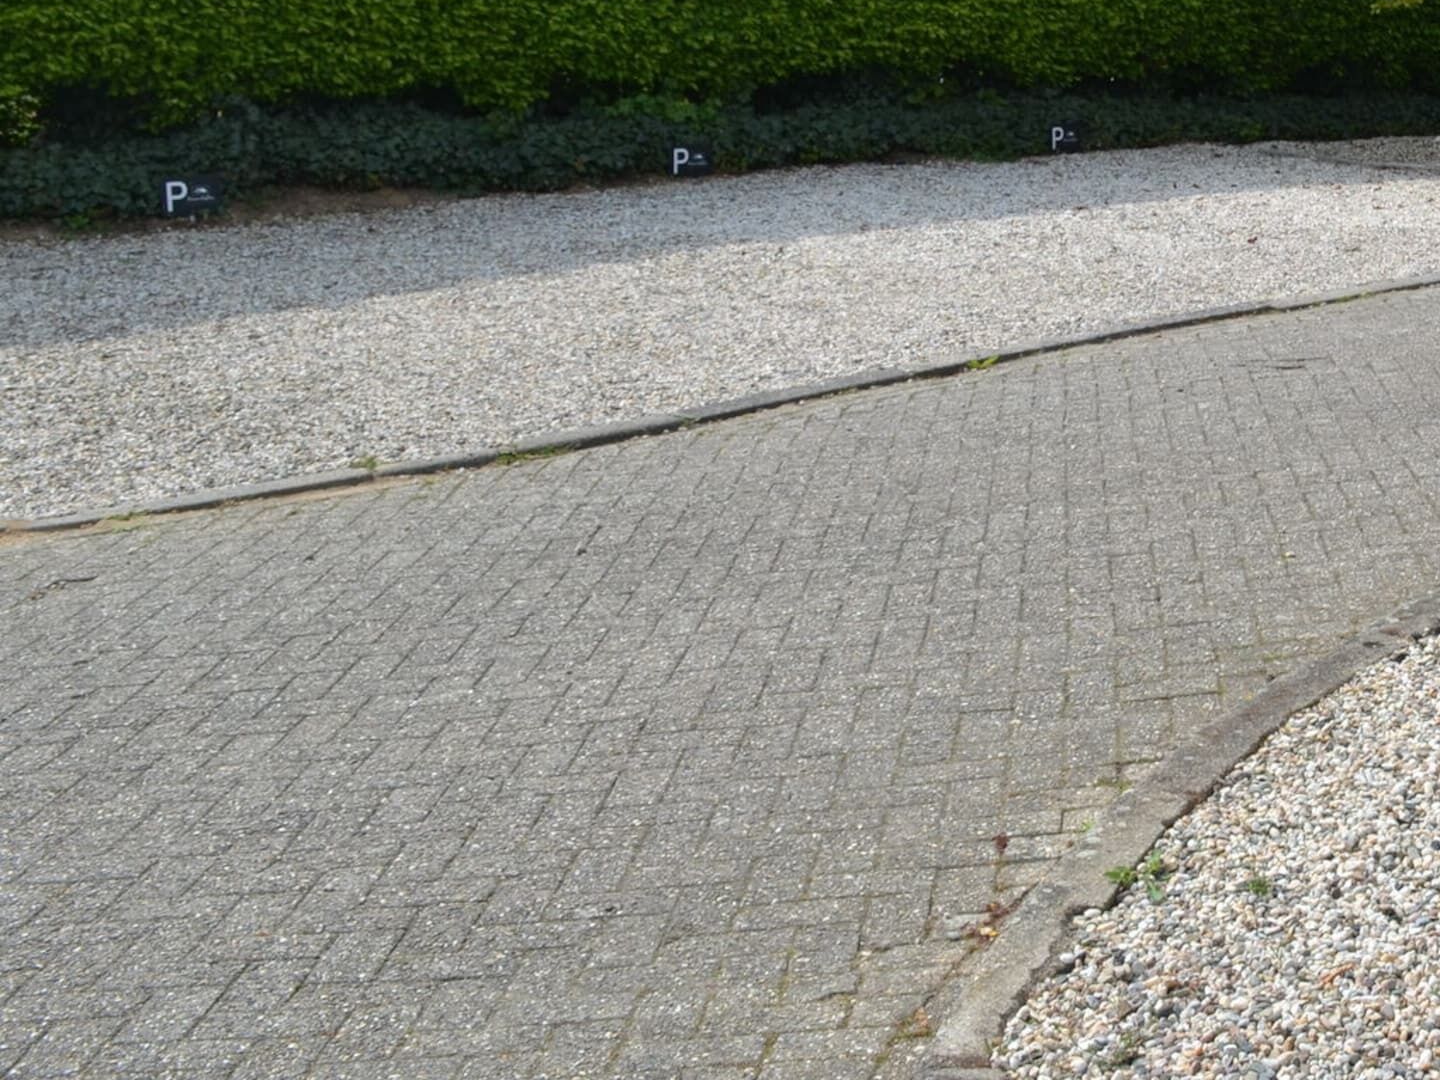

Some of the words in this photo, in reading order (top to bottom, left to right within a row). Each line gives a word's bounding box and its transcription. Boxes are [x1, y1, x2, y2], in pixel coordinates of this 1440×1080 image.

[1052, 126, 1064, 150] P
[673, 148, 689, 175] P
[165, 181, 188, 213] P
